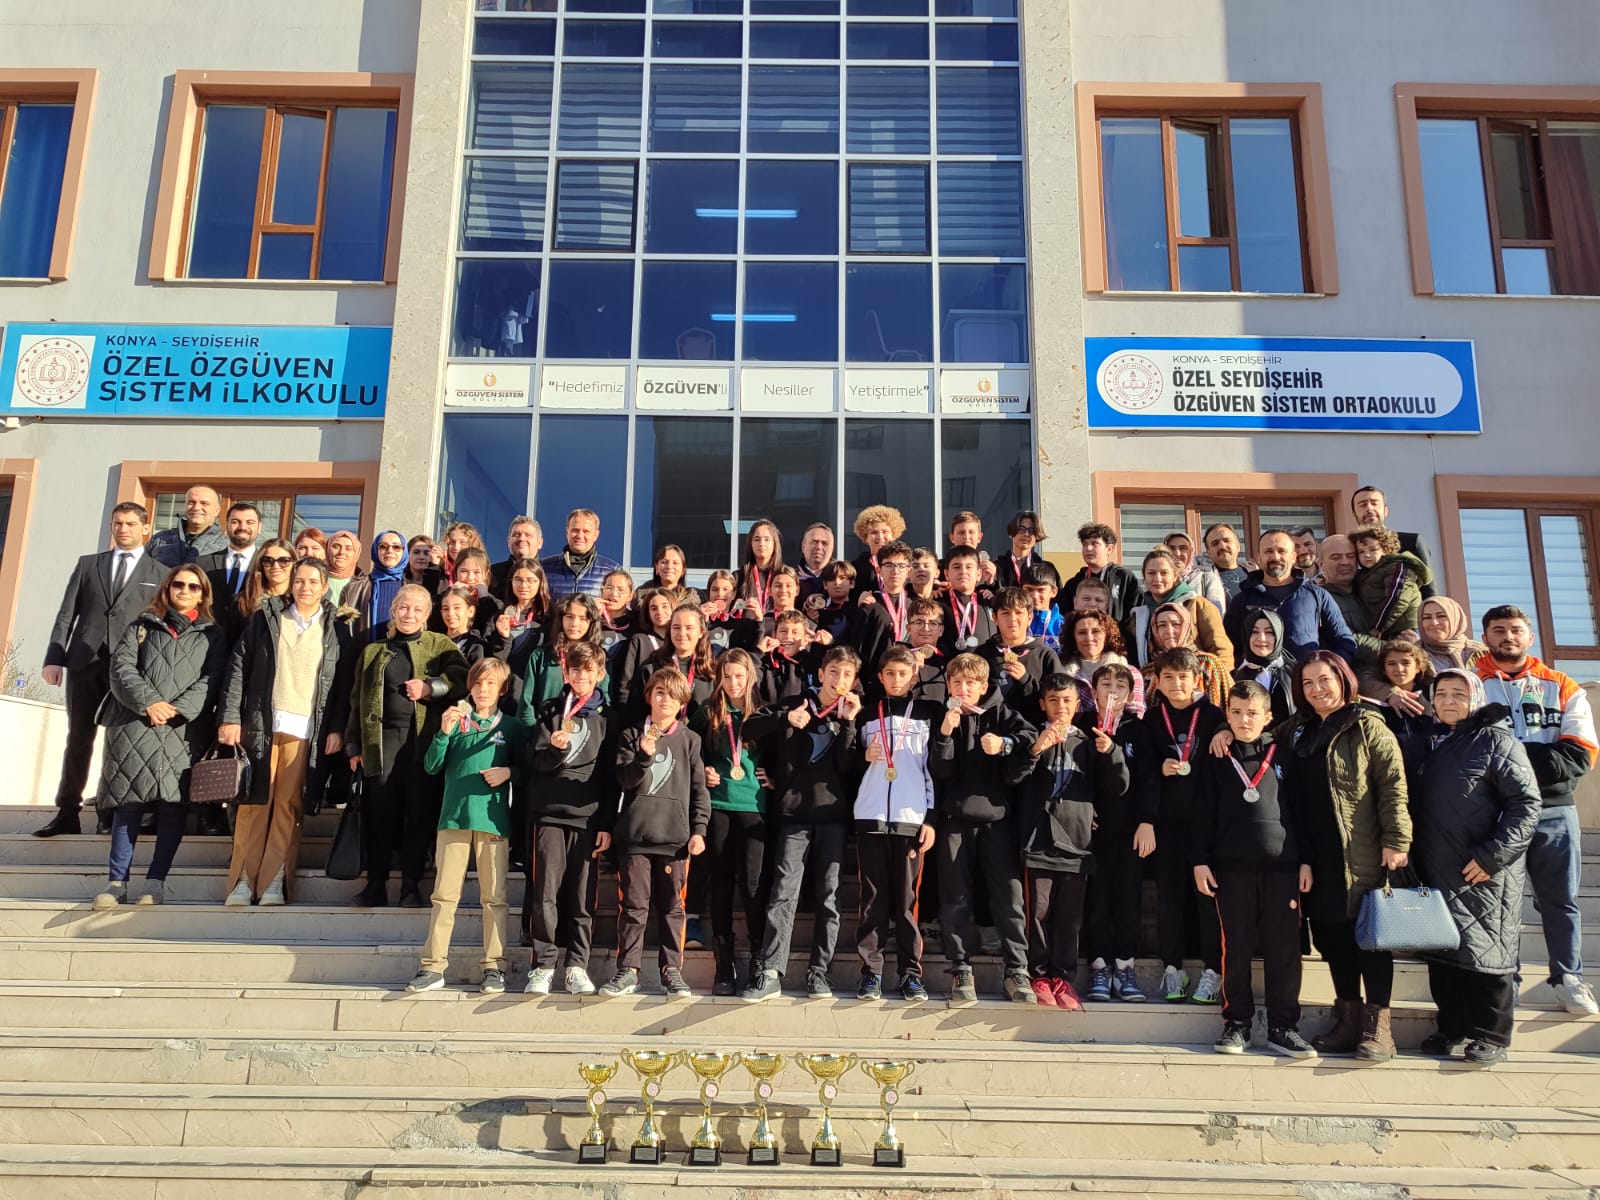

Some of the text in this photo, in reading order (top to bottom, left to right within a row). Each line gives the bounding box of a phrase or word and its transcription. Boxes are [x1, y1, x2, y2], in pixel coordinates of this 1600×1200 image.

[106, 335, 157, 346] KONYA
[171, 334, 260, 348] SEYDİŞEHİR
[103, 350, 180, 377] ÖZEL
[190, 351, 334, 379] ÖZGÜVEN
[1172, 355, 1211, 364] KONYA
[1219, 353, 1282, 366] SEYDİŞEHİR
[1172, 366, 1216, 388] ÖZEL
[1220, 367, 1323, 391] SEYDİŞEHİR
[763, 383, 815, 396] Nesiller
[1173, 391, 1437, 415] ÖZGÜVEN SİSTEM ORTAOKULU
